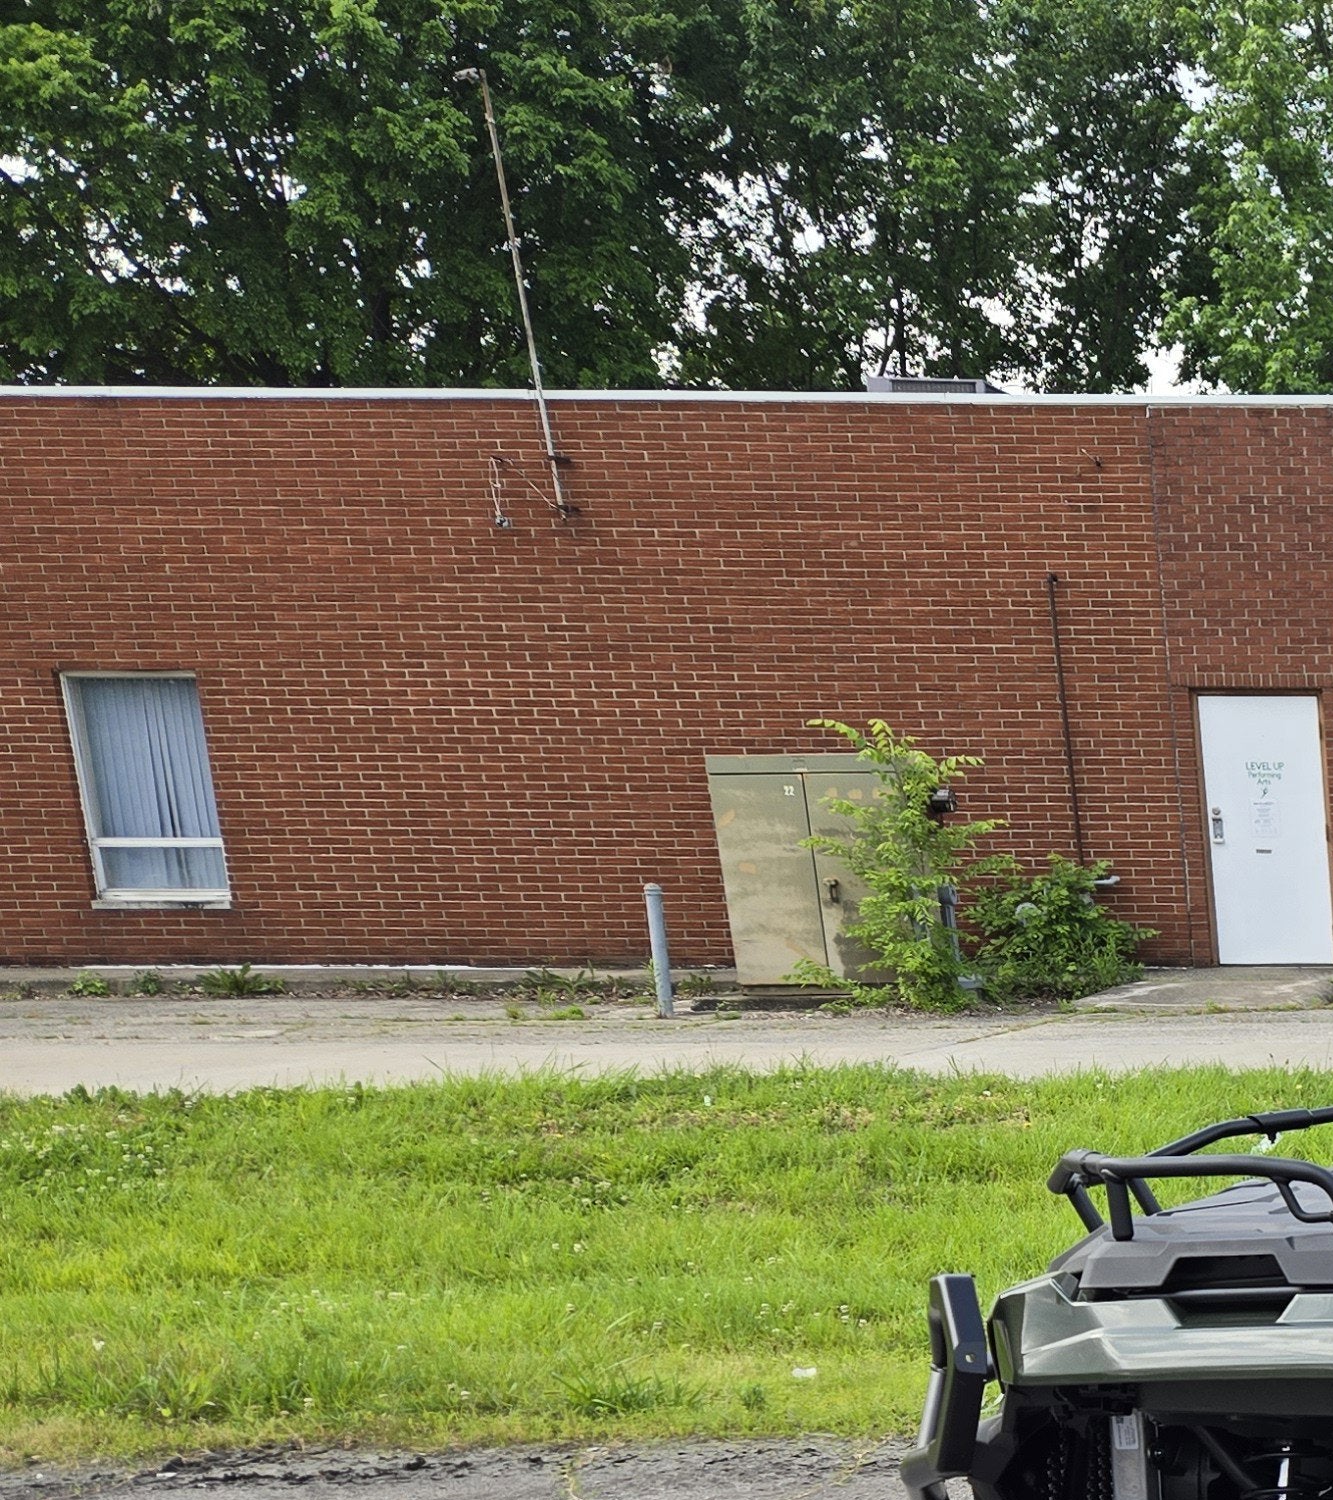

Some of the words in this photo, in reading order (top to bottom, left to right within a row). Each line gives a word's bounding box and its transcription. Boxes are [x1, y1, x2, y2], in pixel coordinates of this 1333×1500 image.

[1245, 762, 1272, 771] LEVEL
[1273, 762, 1285, 771] UP
[1247, 772, 1282, 780] Performing
[784, 785, 795, 796] 22
